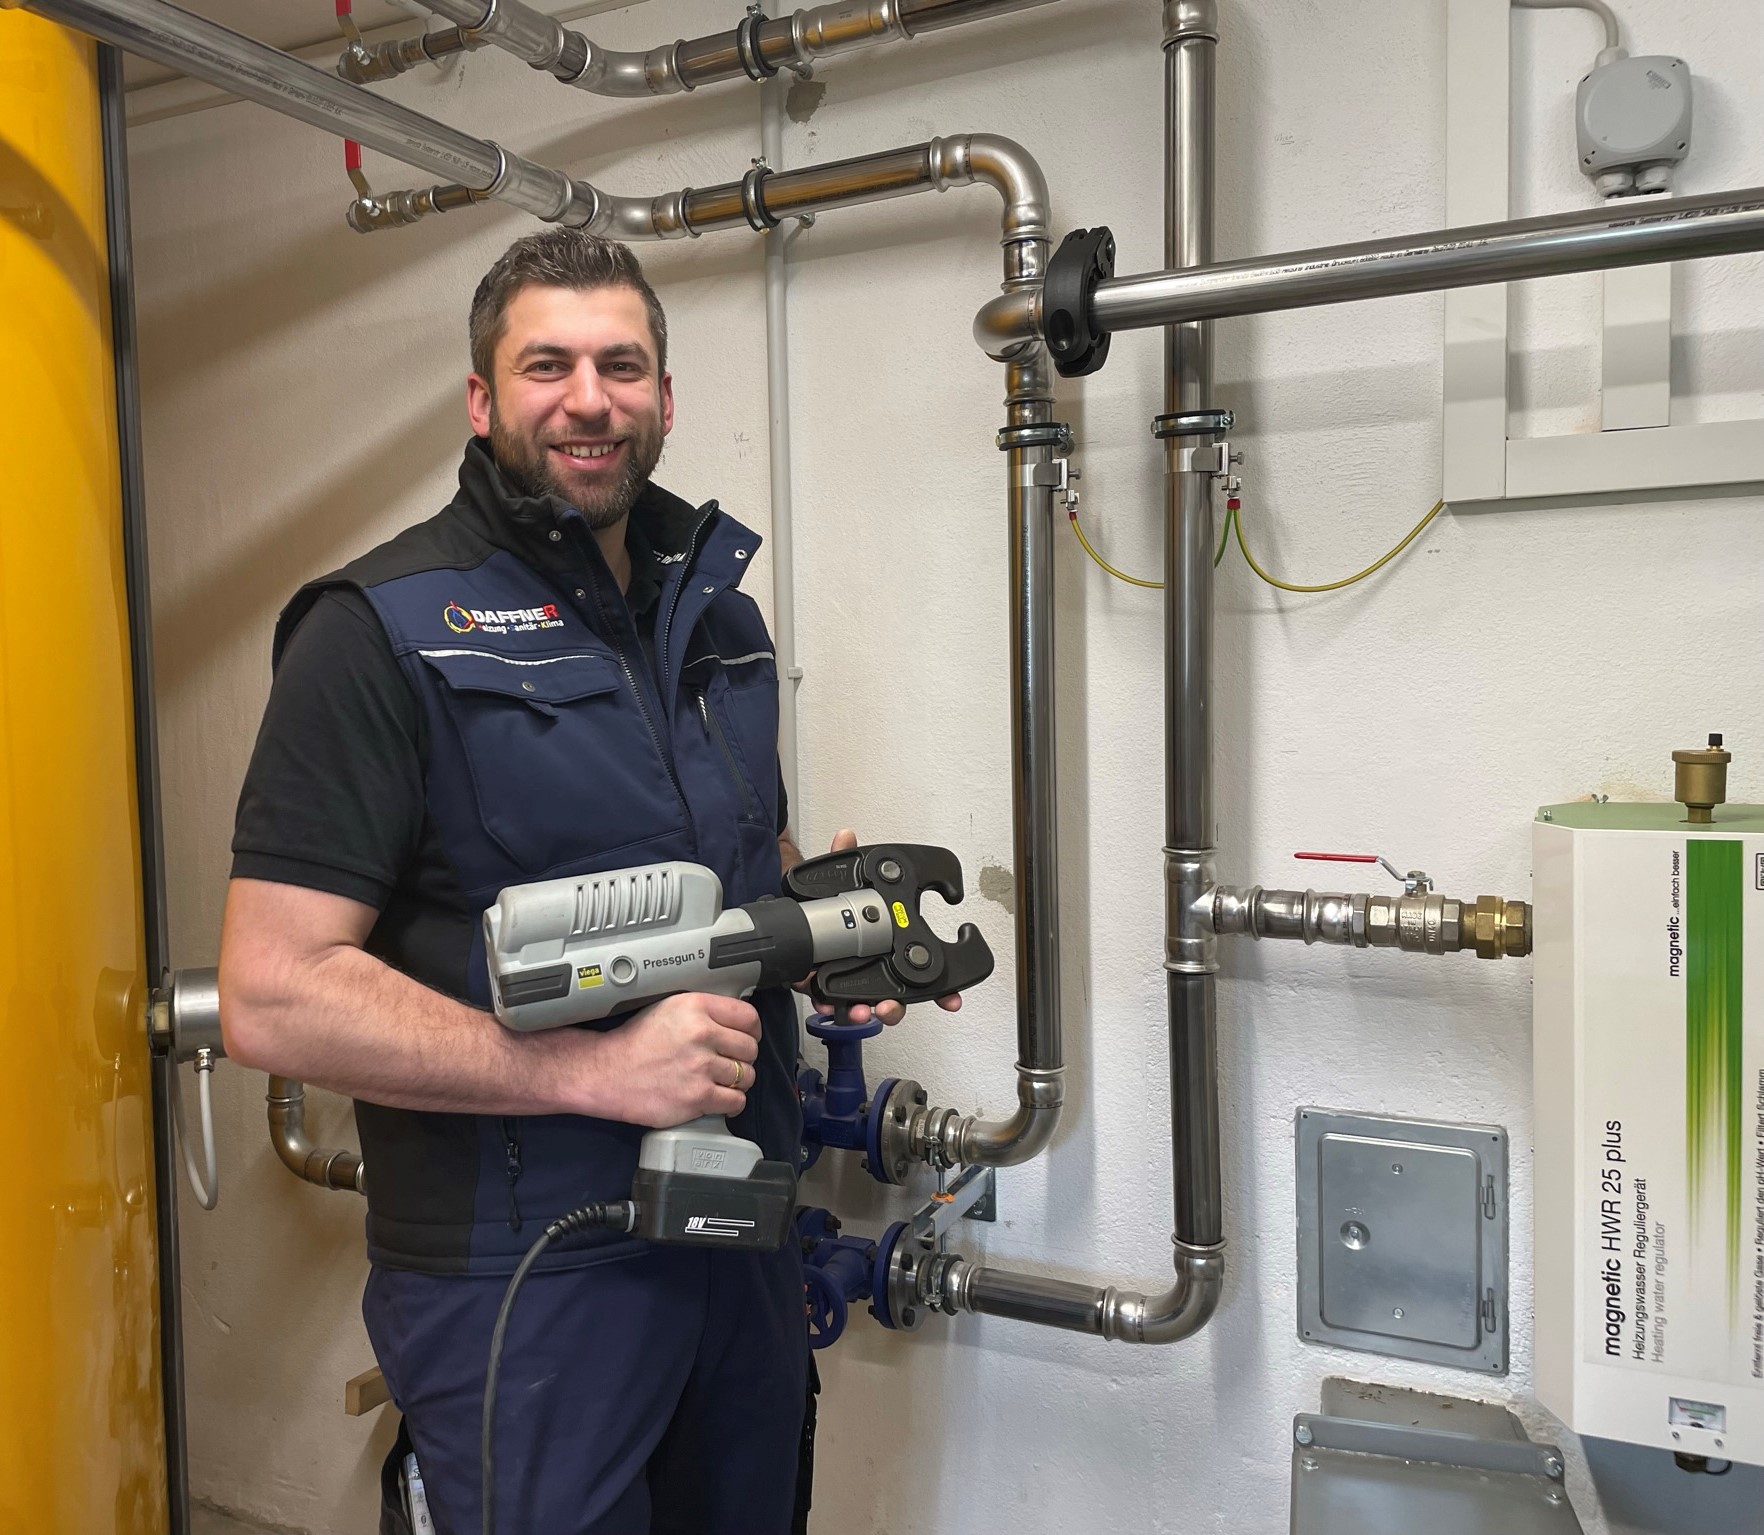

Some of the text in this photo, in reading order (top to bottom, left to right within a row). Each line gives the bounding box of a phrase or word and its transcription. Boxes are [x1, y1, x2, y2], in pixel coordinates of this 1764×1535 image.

[470, 604, 559, 623] DAFFNER
[541, 619, 564, 629] Klima
[1671, 850, 1680, 876] besser
[1667, 916, 1683, 977] magnetic
[643, 949, 705, 969] Pressgun 5
[579, 967, 600, 977] viega
[687, 1216, 706, 1228] 18V
[1601, 1120, 1626, 1357] magnetic HWR 25 plus
[1632, 1178, 1649, 1360] Heizungswasser Reguliergerät
[1651, 1221, 1667, 1363] Heating water regulator
